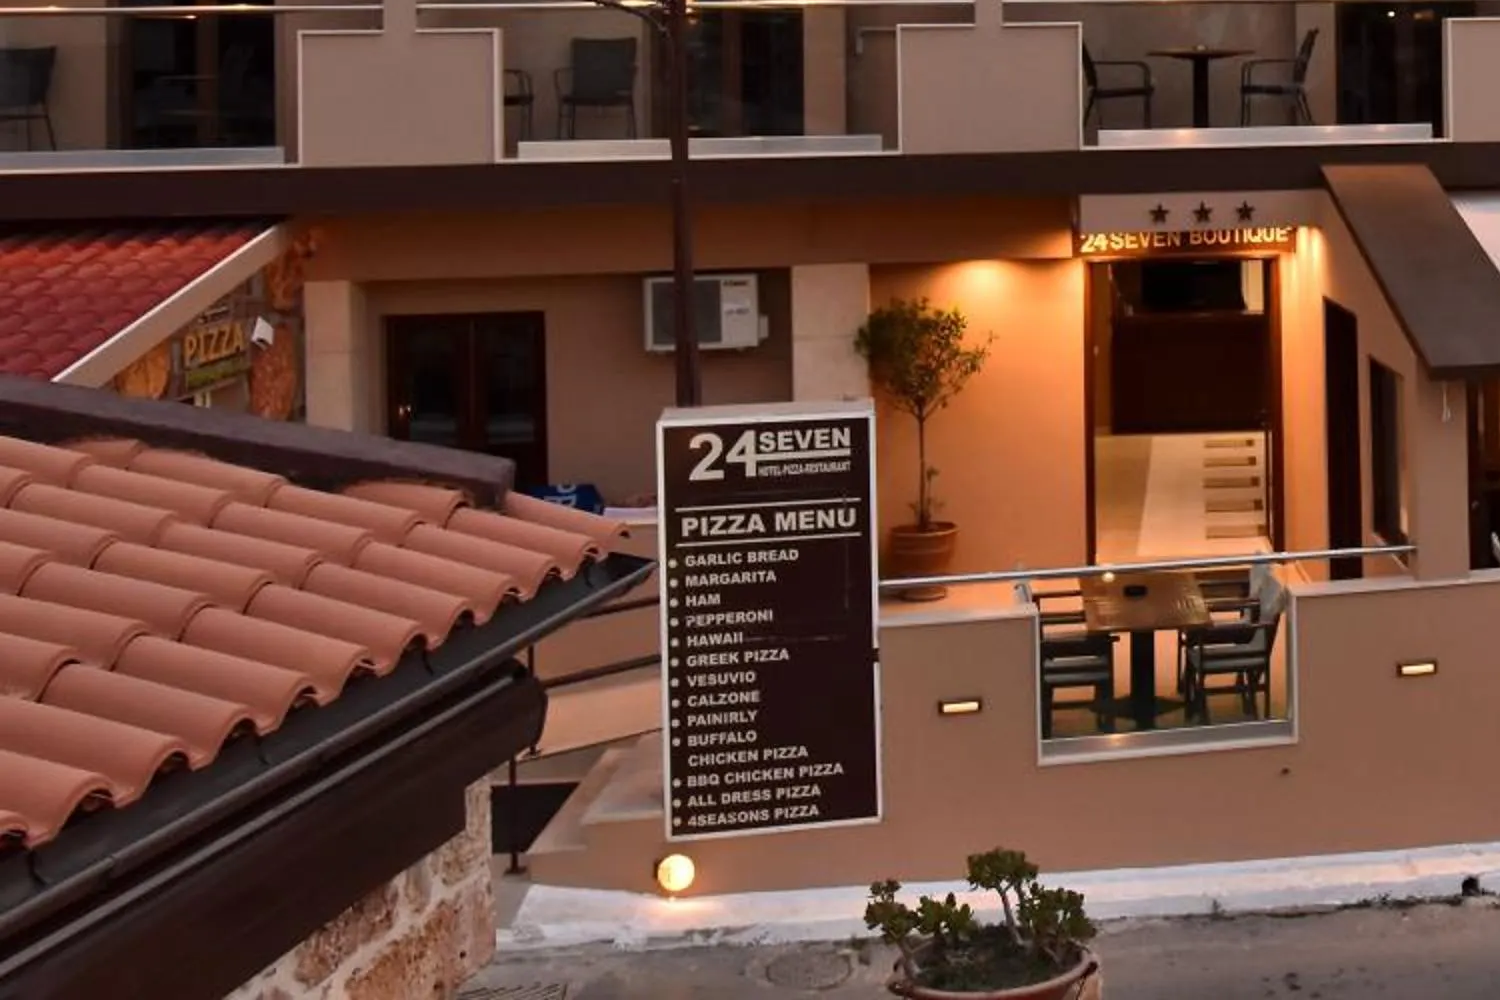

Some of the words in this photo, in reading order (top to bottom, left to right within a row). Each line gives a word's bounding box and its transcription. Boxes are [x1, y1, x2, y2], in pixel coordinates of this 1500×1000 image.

[1188, 226, 1290, 247] BOUTIQUE
[184, 322, 245, 369] PIZZA
[681, 513, 765, 536] PIZZA
[774, 507, 856, 531] MENU
[685, 551, 742, 567] GARLIC
[747, 548, 798, 563] BREAD
[685, 569, 776, 587] MARGARITA
[685, 593, 720, 607] HAM
[685, 608, 773, 627] PEPPERONI
[687, 631, 743, 647] HAWAII
[686, 651, 739, 667] GREEK
[744, 647, 789, 663] PIZZA
[686, 670, 756, 687] VESUVIO
[687, 690, 760, 707] CALZONE
[687, 729, 757, 746] BUFFALO
[687, 748, 758, 767] CHICKEN
[763, 745, 808, 761] PIZZA
[687, 773, 720, 787] BBQ
[724, 766, 794, 784] CHICKEN
[799, 762, 843, 777] PIZZA
[687, 795, 716, 807] ALL
[721, 788, 771, 805] DRESS
[776, 783, 820, 799] PIZZA
[774, 803, 819, 819] PIZZA
